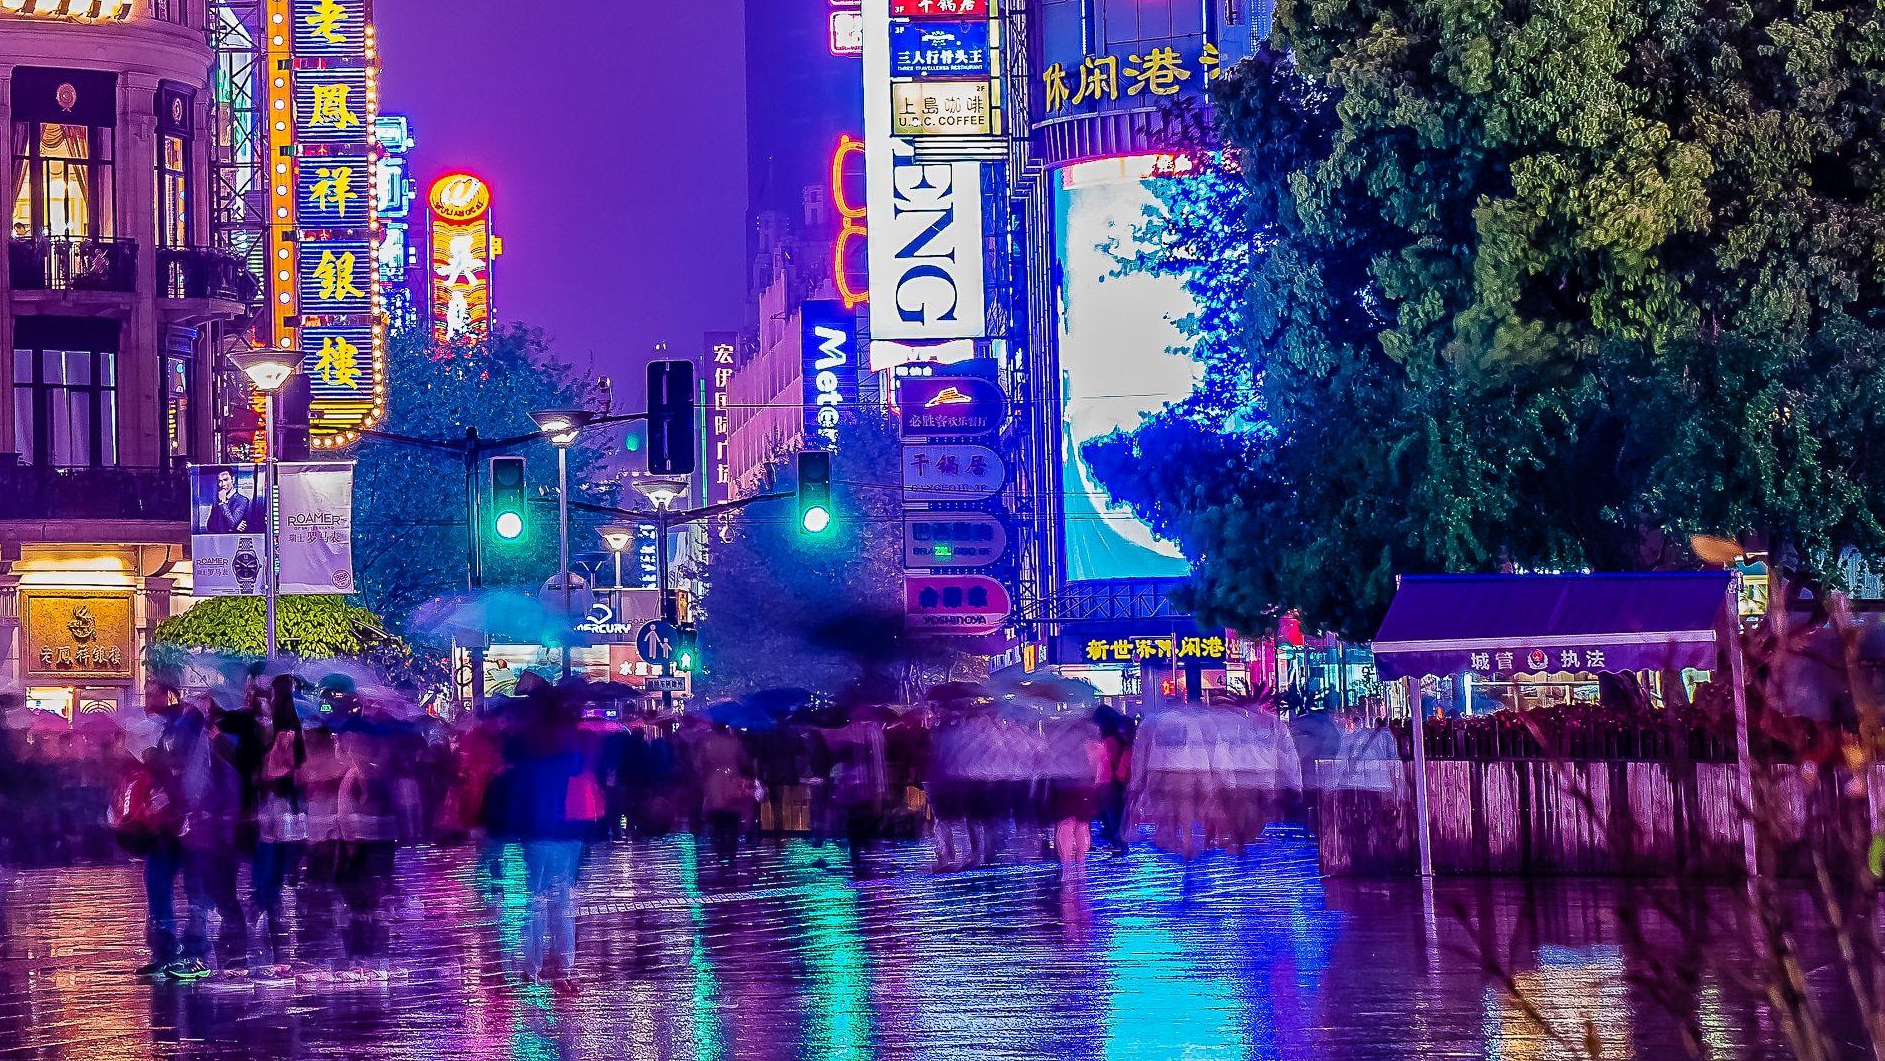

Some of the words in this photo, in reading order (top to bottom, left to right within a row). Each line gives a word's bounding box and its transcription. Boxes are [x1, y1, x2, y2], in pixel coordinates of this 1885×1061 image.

[939, 116, 985, 126] COFFEE
[287, 513, 341, 527] ROAMER
[196, 557, 229, 566] ROAMER
[1471, 651, 1514, 672] 城管
[1561, 649, 1606, 670] 执法
